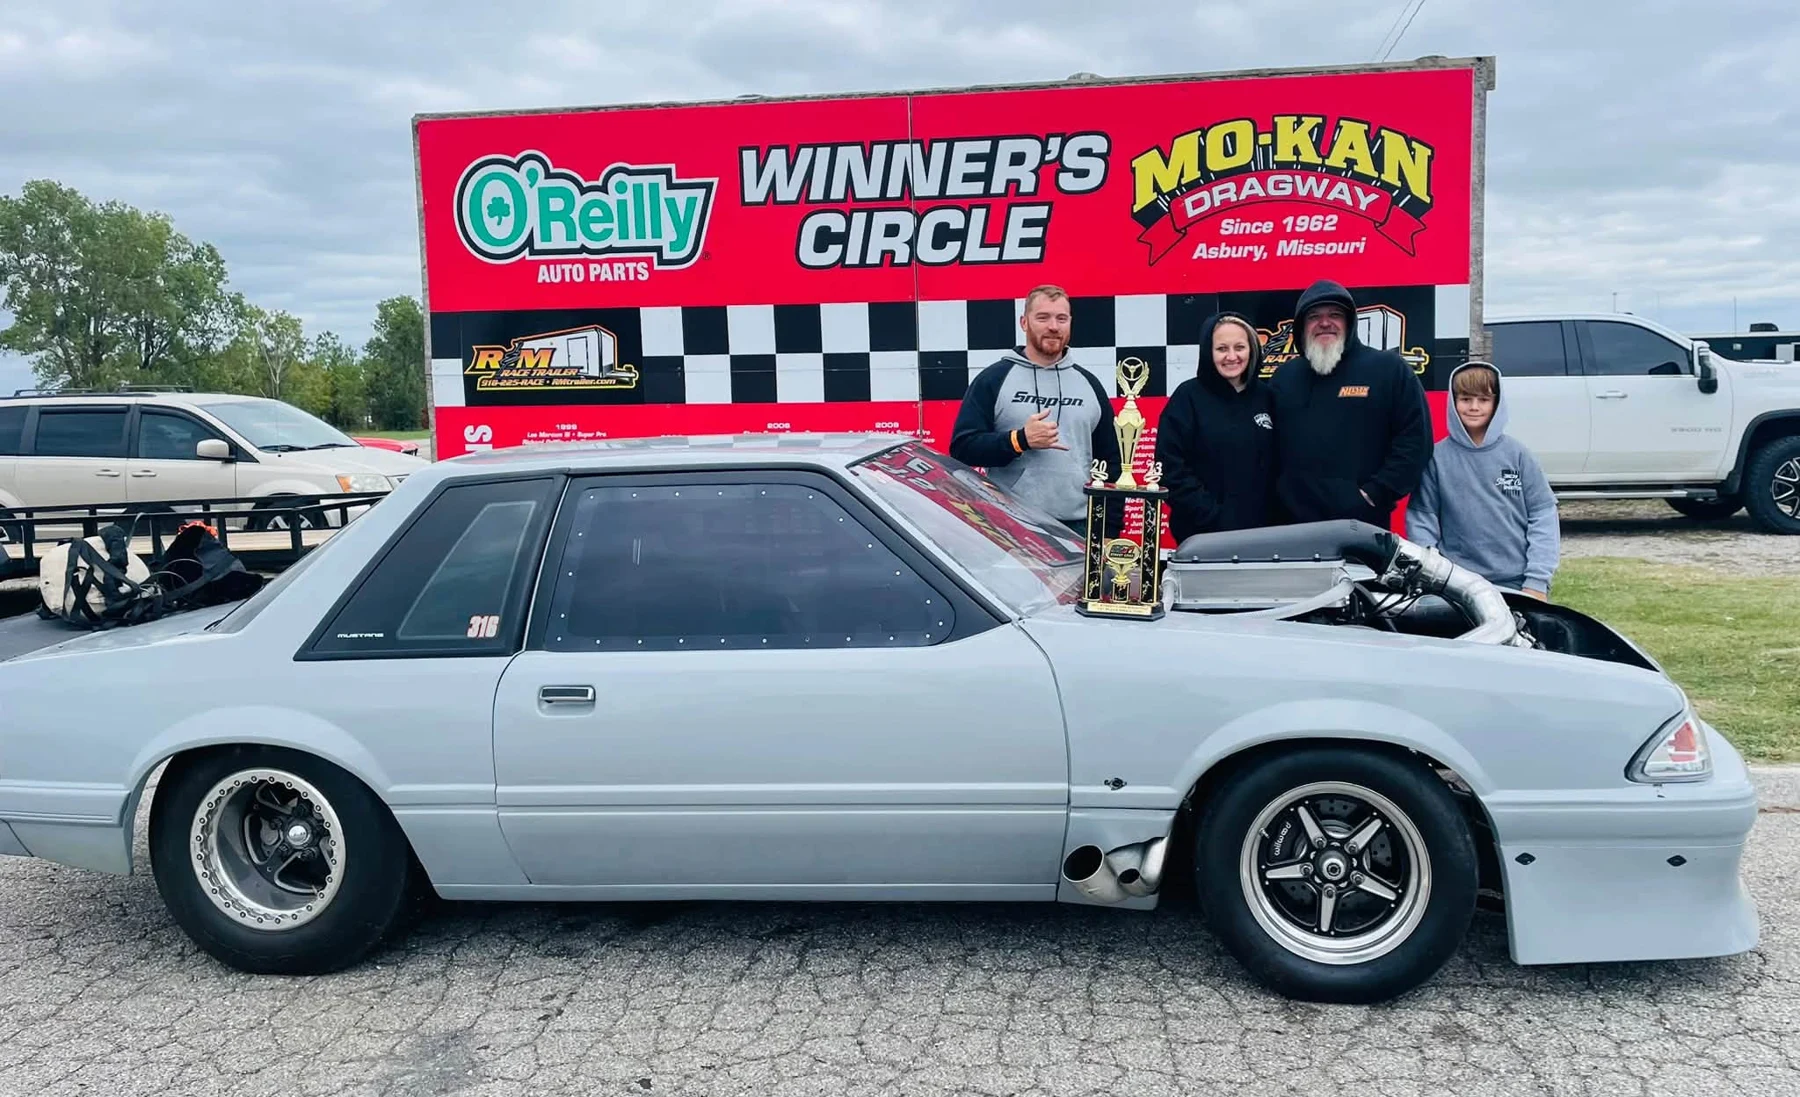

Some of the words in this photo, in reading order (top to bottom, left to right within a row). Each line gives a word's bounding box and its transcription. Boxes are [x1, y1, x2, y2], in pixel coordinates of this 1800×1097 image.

[739, 132, 1111, 206] WINNER'S
[1184, 174, 1379, 219] DRAGWAY
[468, 166, 699, 253] O'Reilly
[796, 202, 1053, 269] CIRCLE
[1220, 219, 1274, 236] Since
[1281, 214, 1338, 233] 1962
[1192, 241, 1268, 262] Asbury,
[1276, 237, 1366, 257] Missouri
[537, 264, 585, 283] AUTO
[589, 261, 649, 282] PARTS
[501, 368, 532, 377] RACE
[532, 367, 579, 376] TRAILER
[467, 616, 500, 638] 316
